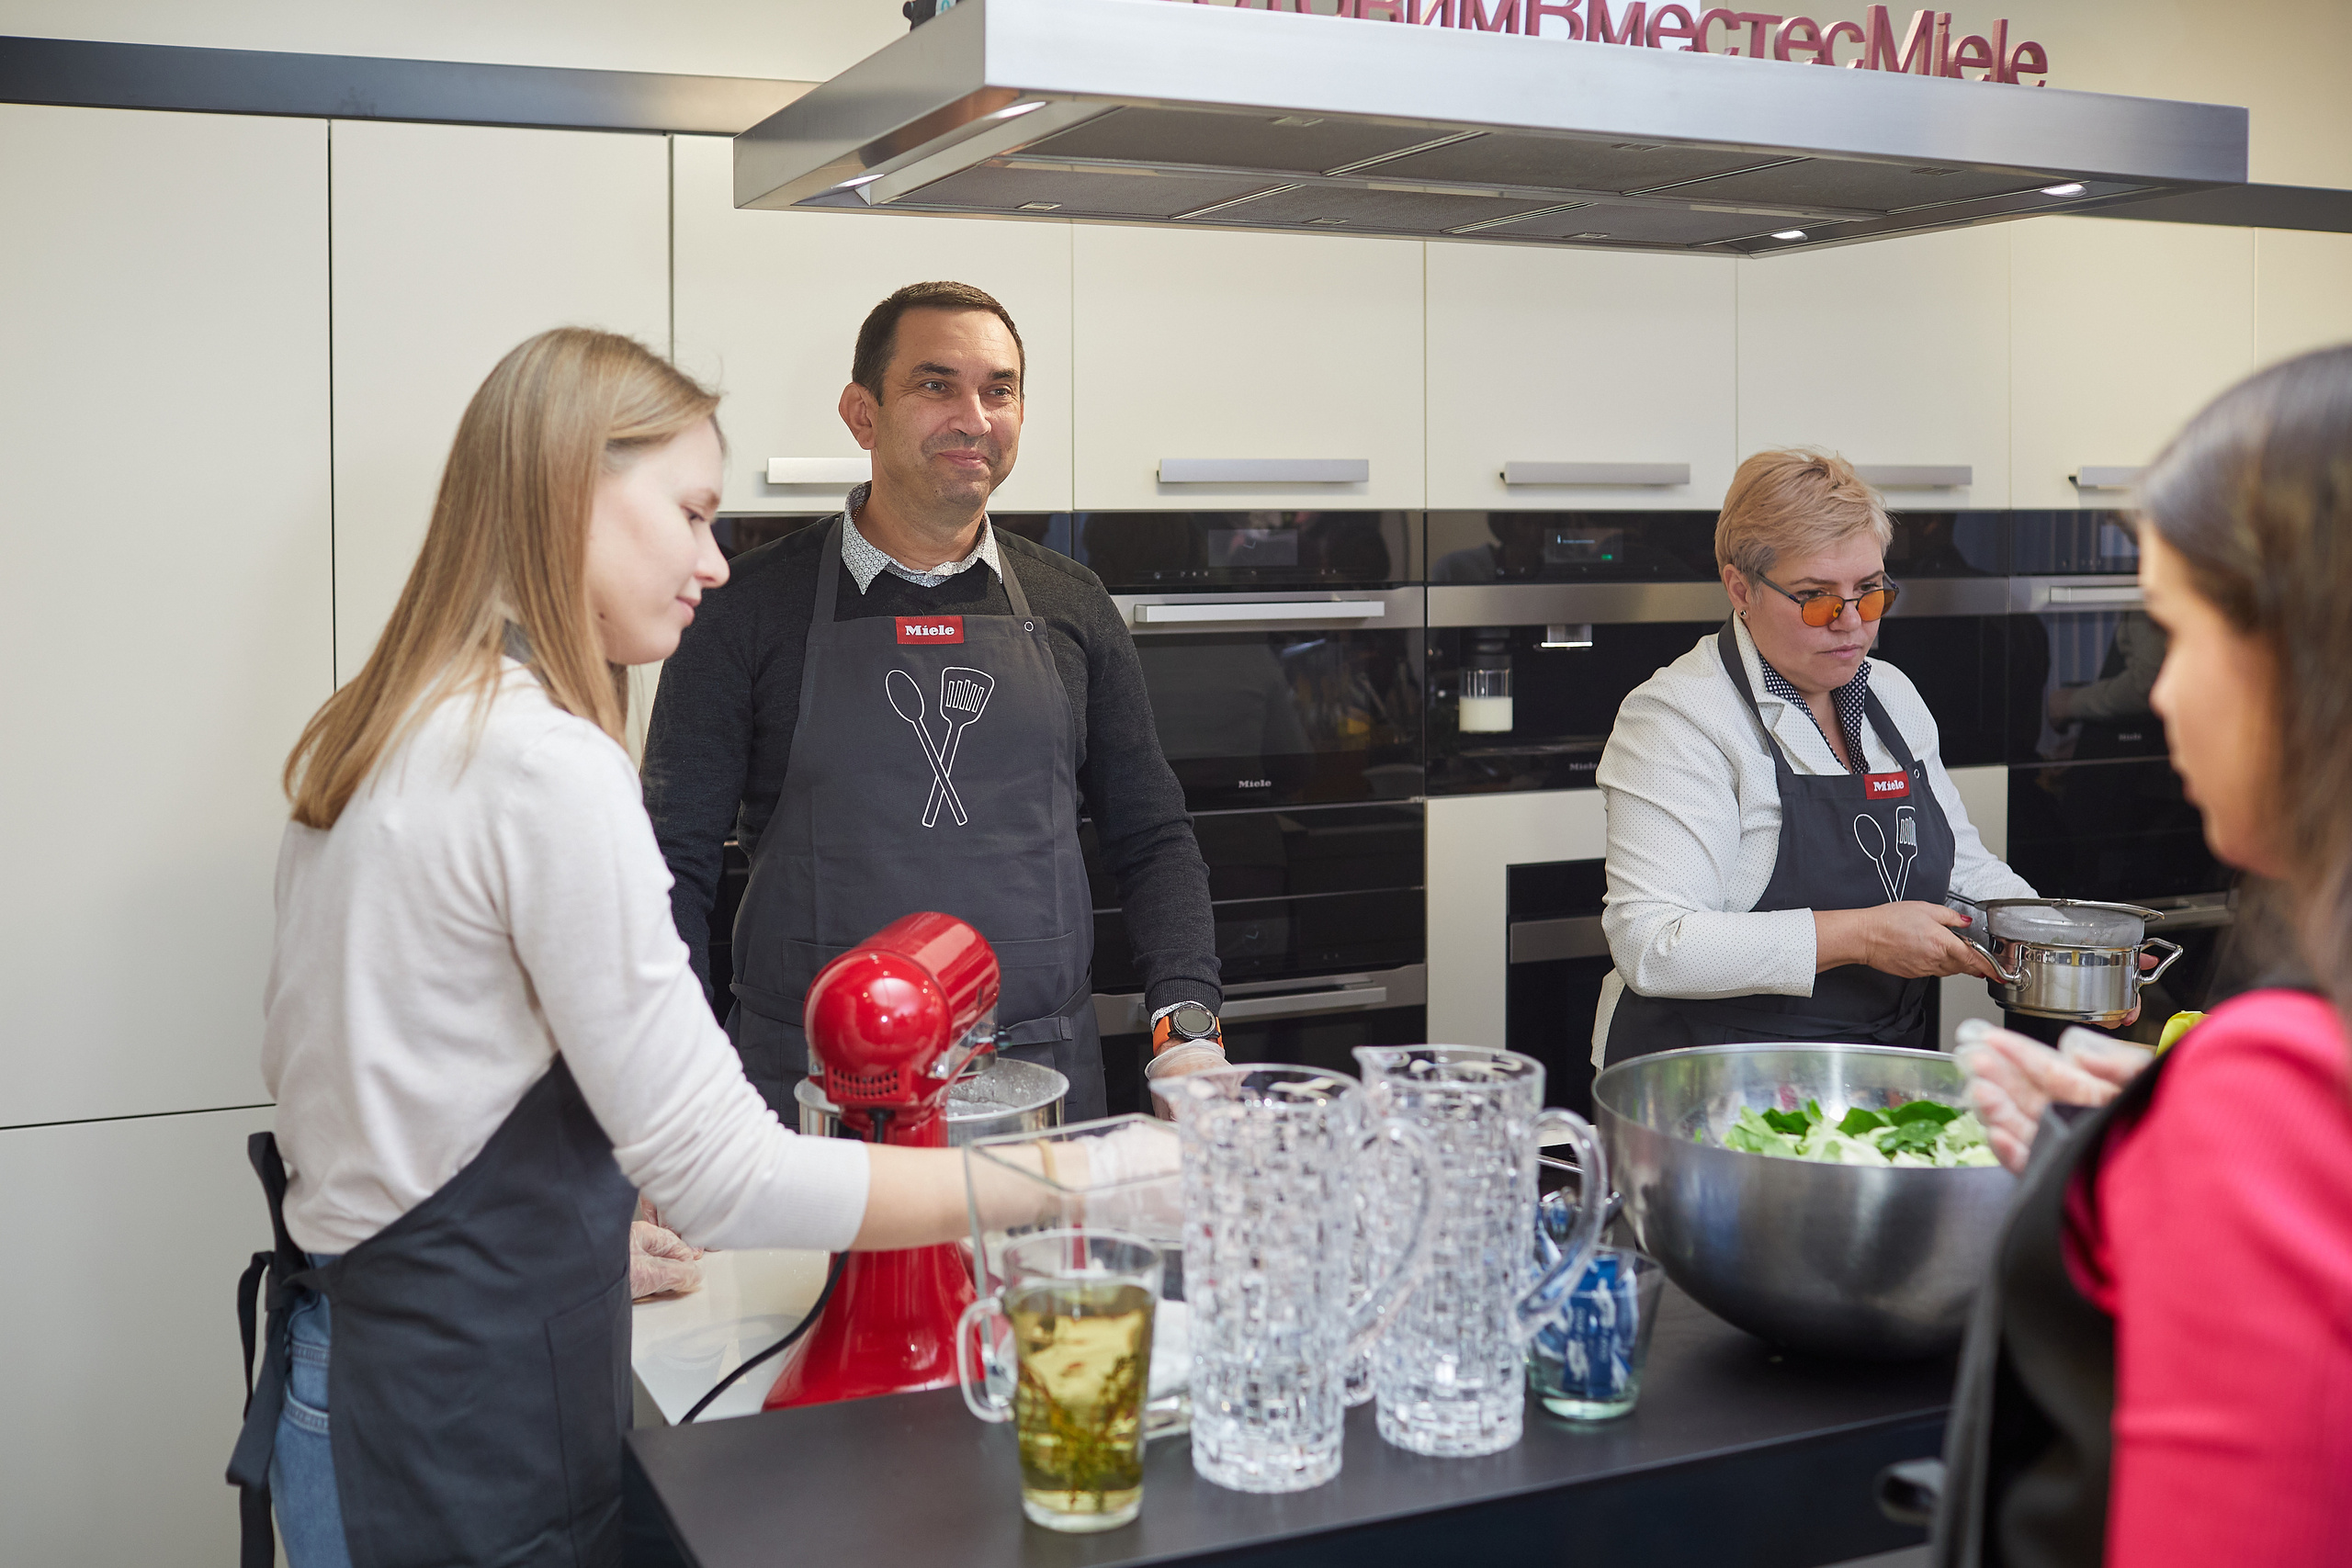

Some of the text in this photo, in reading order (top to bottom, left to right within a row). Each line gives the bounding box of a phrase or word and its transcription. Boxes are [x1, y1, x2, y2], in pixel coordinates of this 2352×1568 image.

[904, 625, 955, 636] Miele
[1238, 779, 1272, 788] Miele
[1873, 780, 1905, 792] Miele
